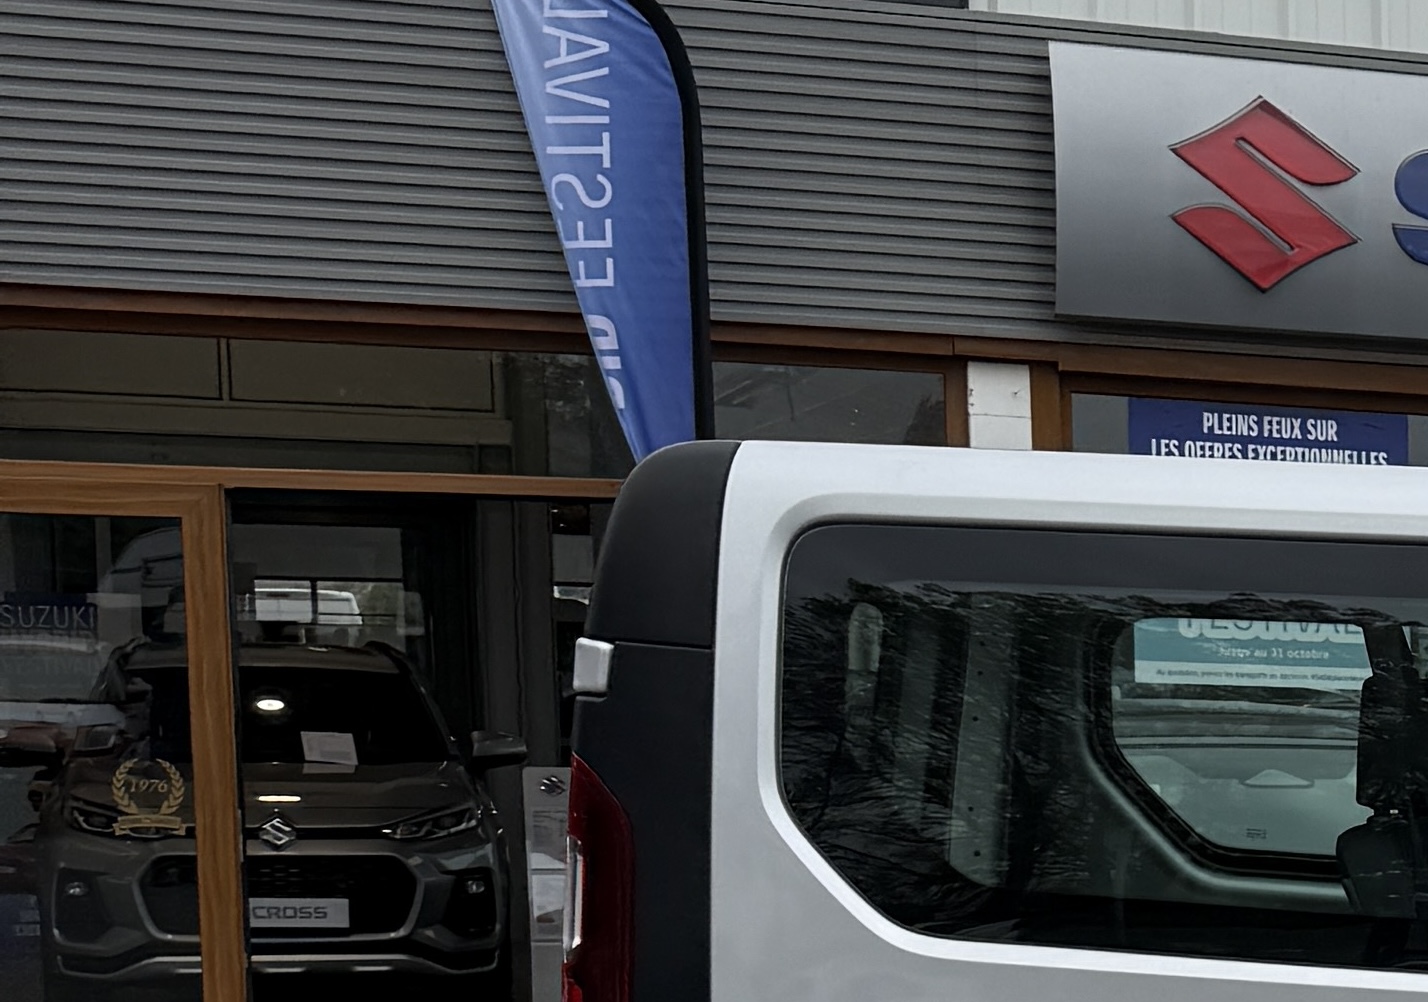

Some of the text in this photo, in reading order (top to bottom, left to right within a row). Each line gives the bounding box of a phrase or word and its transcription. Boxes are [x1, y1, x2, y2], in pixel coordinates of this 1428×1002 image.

[1203, 411, 1338, 442] PLEINS FEUX SUR
[1151, 438, 1179, 456] LES
[1184, 440, 1243, 459] OFFRES
[0, 603, 95, 629] SUZUKI
[130, 779, 168, 792] 1976
[252, 906, 328, 919] CROSS
